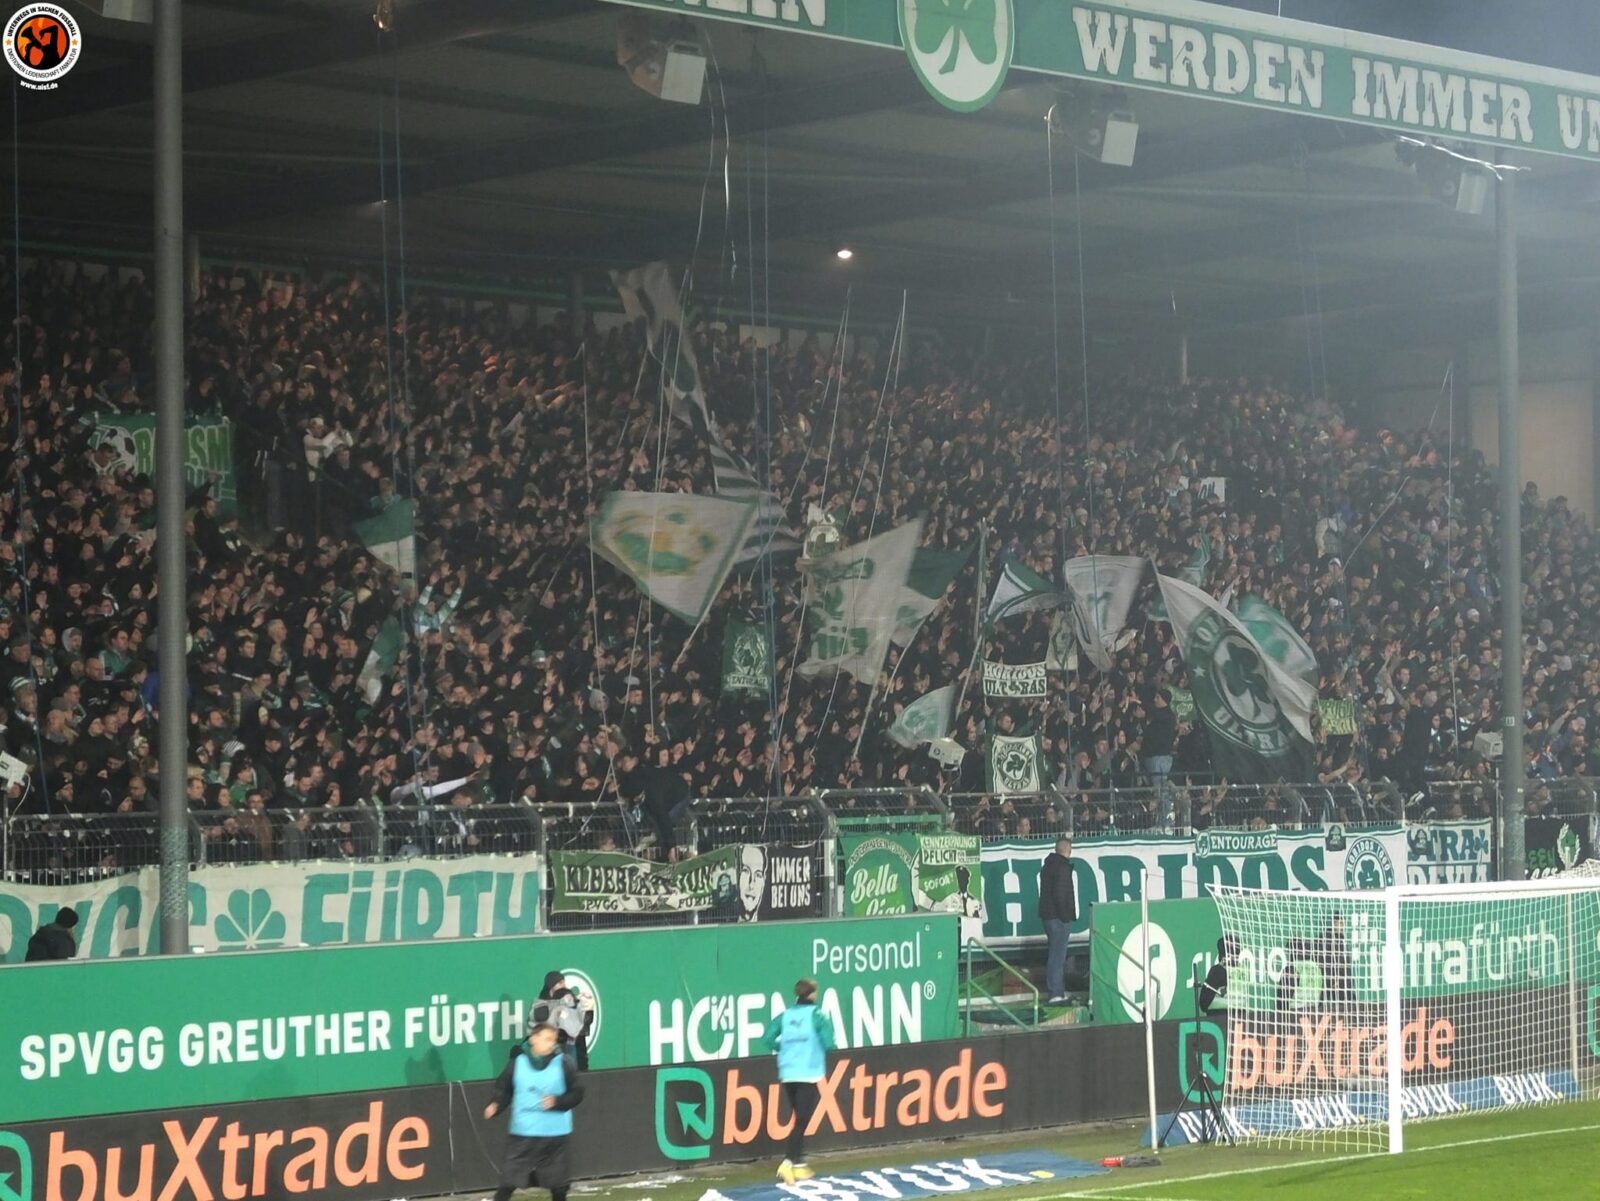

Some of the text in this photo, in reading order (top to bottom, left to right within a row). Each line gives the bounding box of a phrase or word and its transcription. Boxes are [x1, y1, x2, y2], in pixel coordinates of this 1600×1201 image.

[1071, 7, 1325, 108] WERDEN
[1351, 56, 1534, 143] IMMER
[923, 849, 957, 864] PFLICHT
[1210, 834, 1278, 851] ENTOURAGE
[1346, 840, 1391, 873] HORIDOS 1000
[771, 857, 809, 883] IMMER
[850, 862, 899, 904] Bella
[771, 883, 811, 909] BEI UNS
[813, 931, 921, 975] Personal
[20, 994, 524, 1081] SPVGG GREUTHER FÜRTH
[1231, 1006, 1456, 1091] buXtrade
[722, 1047, 1008, 1146] buXtrade
[45, 1100, 431, 1201] buXtrade
